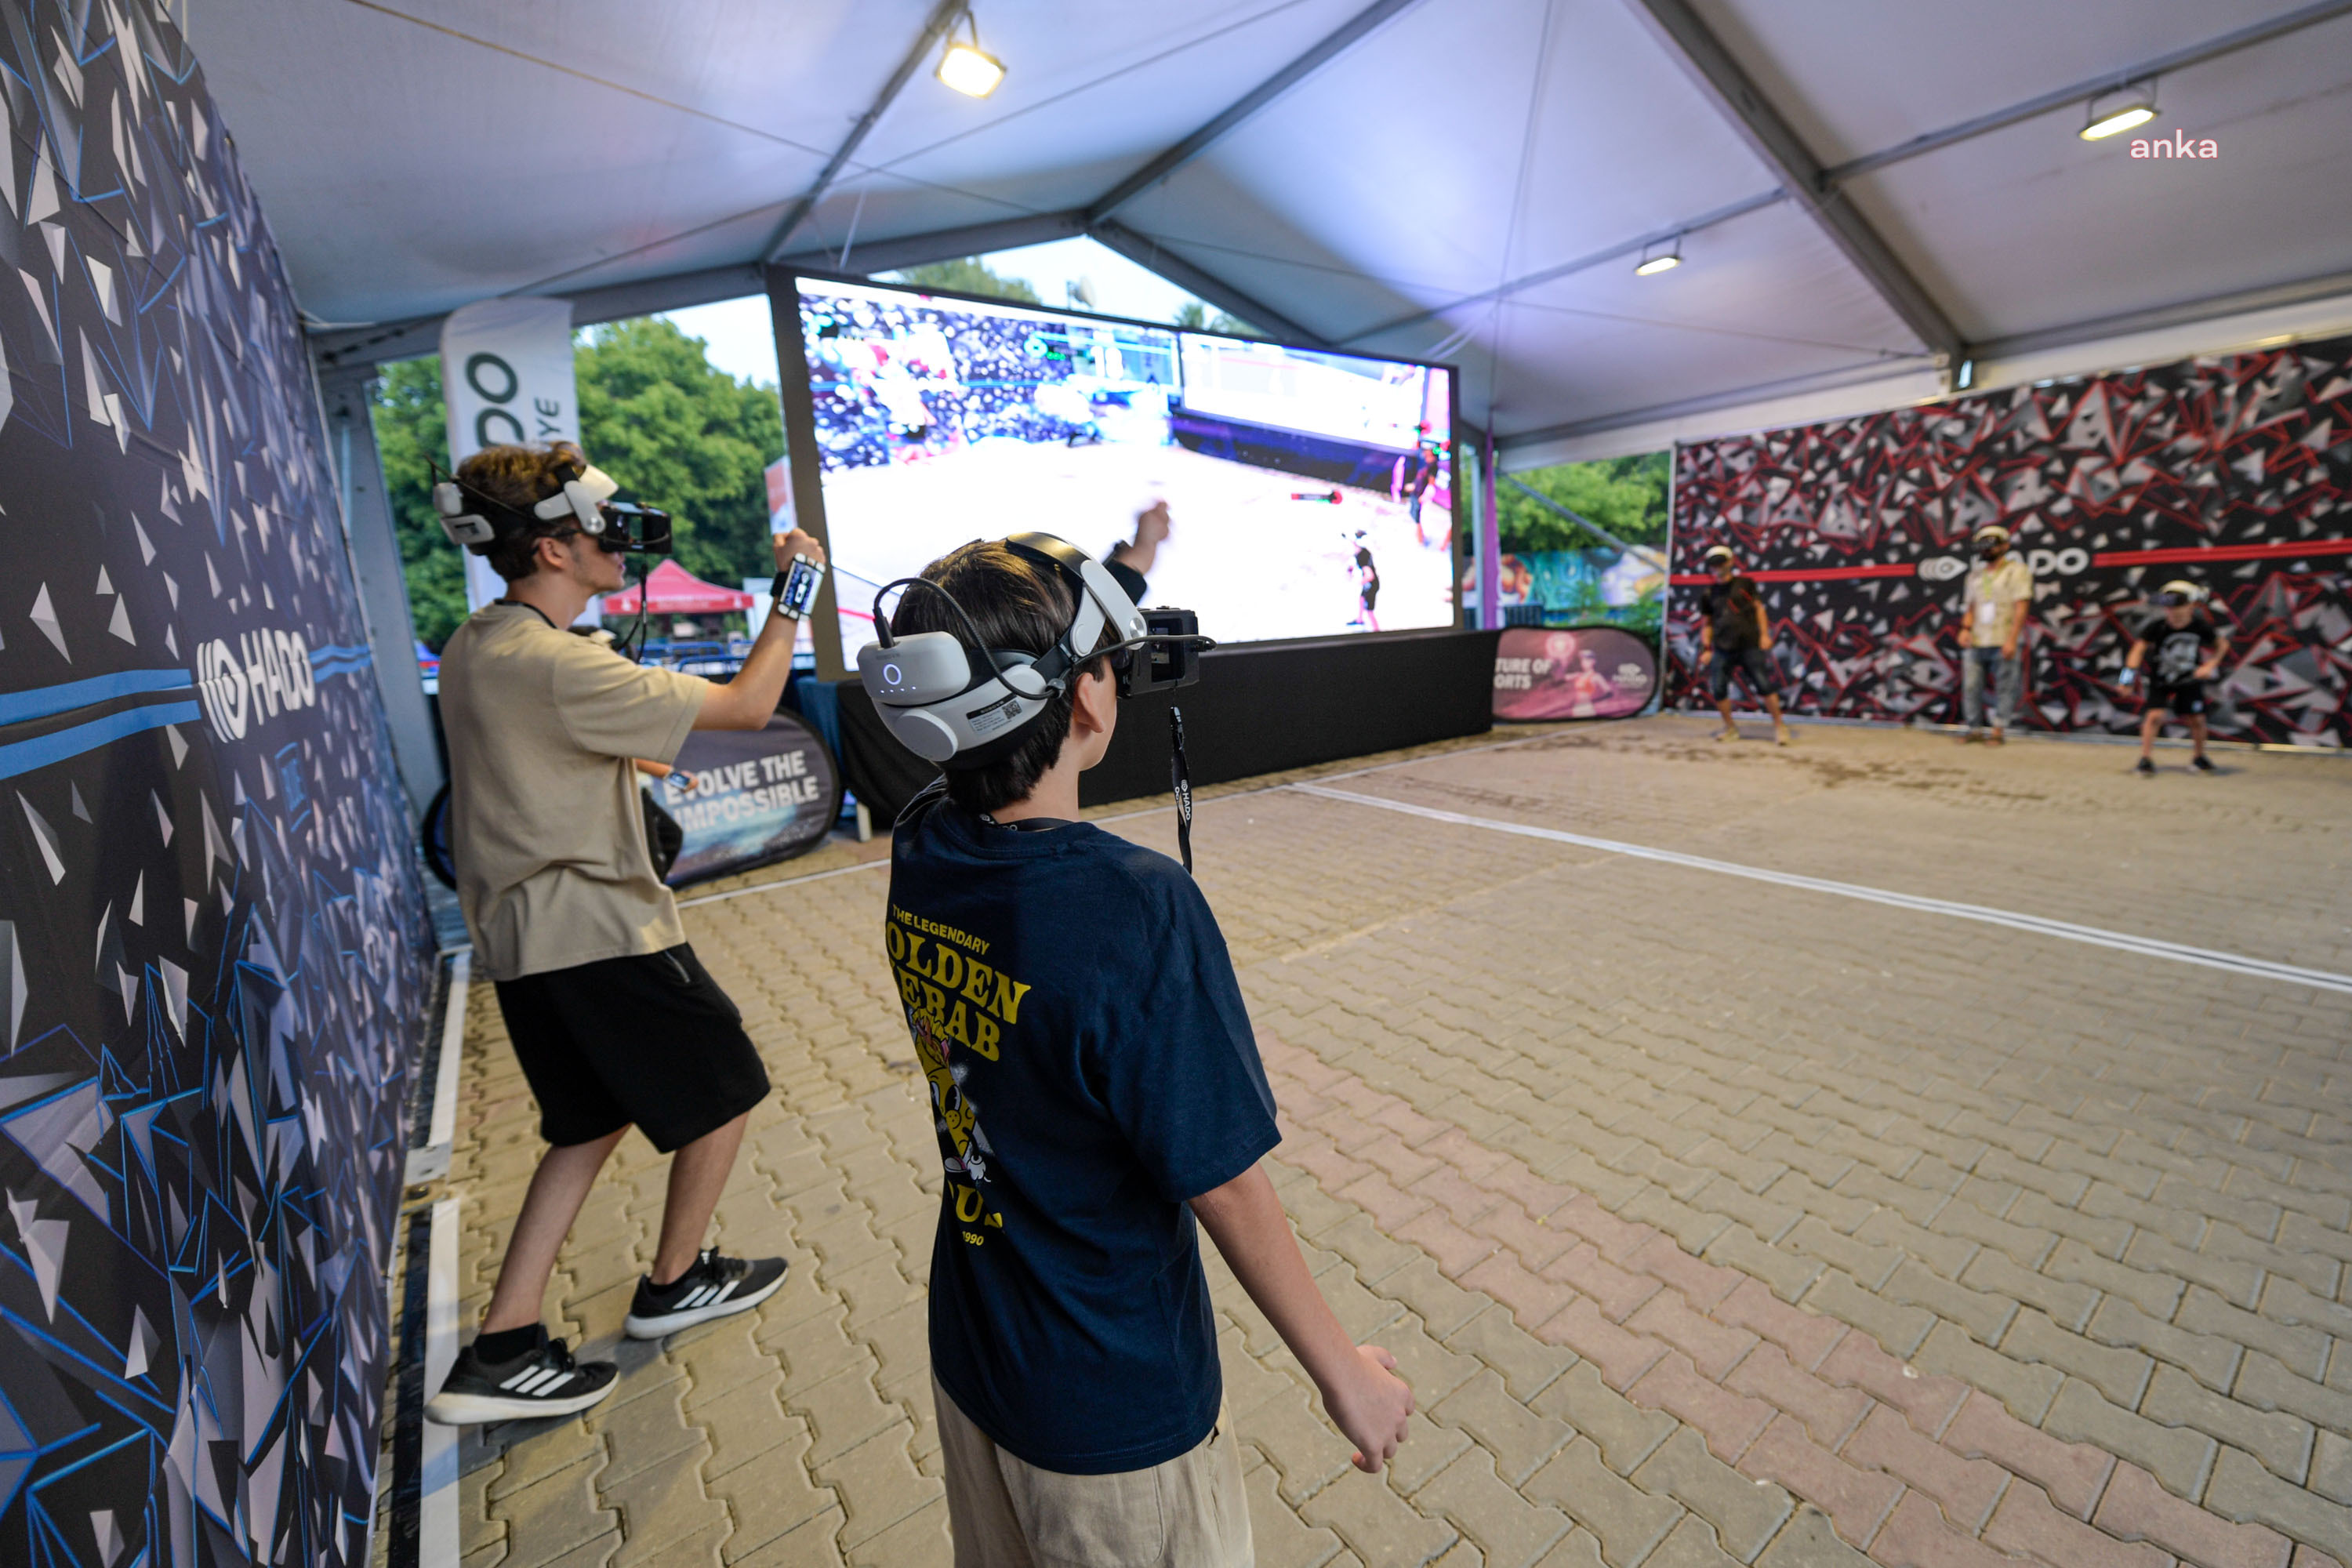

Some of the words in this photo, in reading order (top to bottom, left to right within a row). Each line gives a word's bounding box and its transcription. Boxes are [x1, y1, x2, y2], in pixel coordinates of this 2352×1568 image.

[466, 353, 524, 448] DO
[240, 628, 315, 725] HADO
[1494, 674, 1532, 688] ORTS
[760, 750, 807, 780] THE
[674, 777, 819, 832] IMPOSSIBLE
[1182, 793, 1191, 821] HADO
[893, 904, 913, 925] THE
[913, 916, 989, 955] LEGENDARY
[887, 921, 1031, 1024] OLDEN
[963, 1231, 984, 1246] 1990
